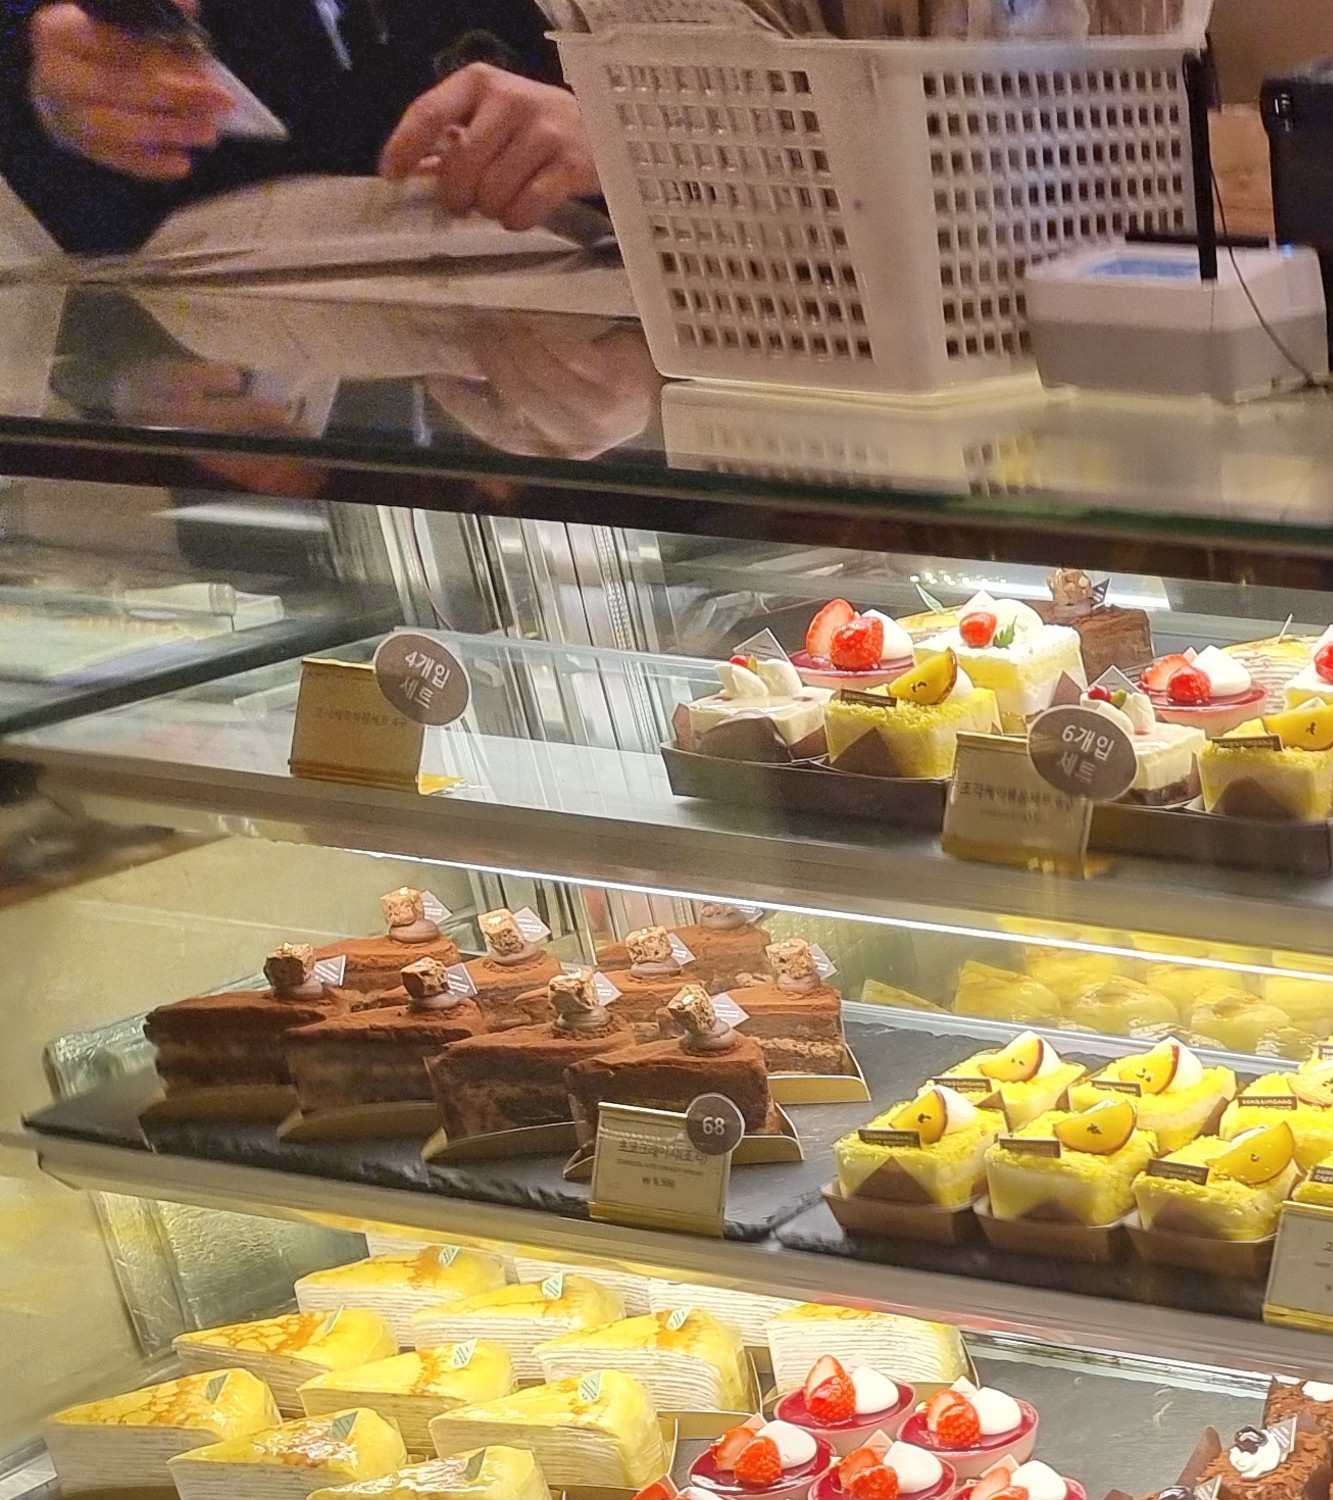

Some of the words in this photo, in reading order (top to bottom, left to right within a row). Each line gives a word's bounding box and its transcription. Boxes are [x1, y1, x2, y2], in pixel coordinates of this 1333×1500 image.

[404, 650, 451, 690] 4개입
[400, 677, 433, 709] 세트
[1062, 724, 1115, 761] 6개입
[1057, 752, 1096, 783] 세트
[702, 1116, 725, 1136] 68
